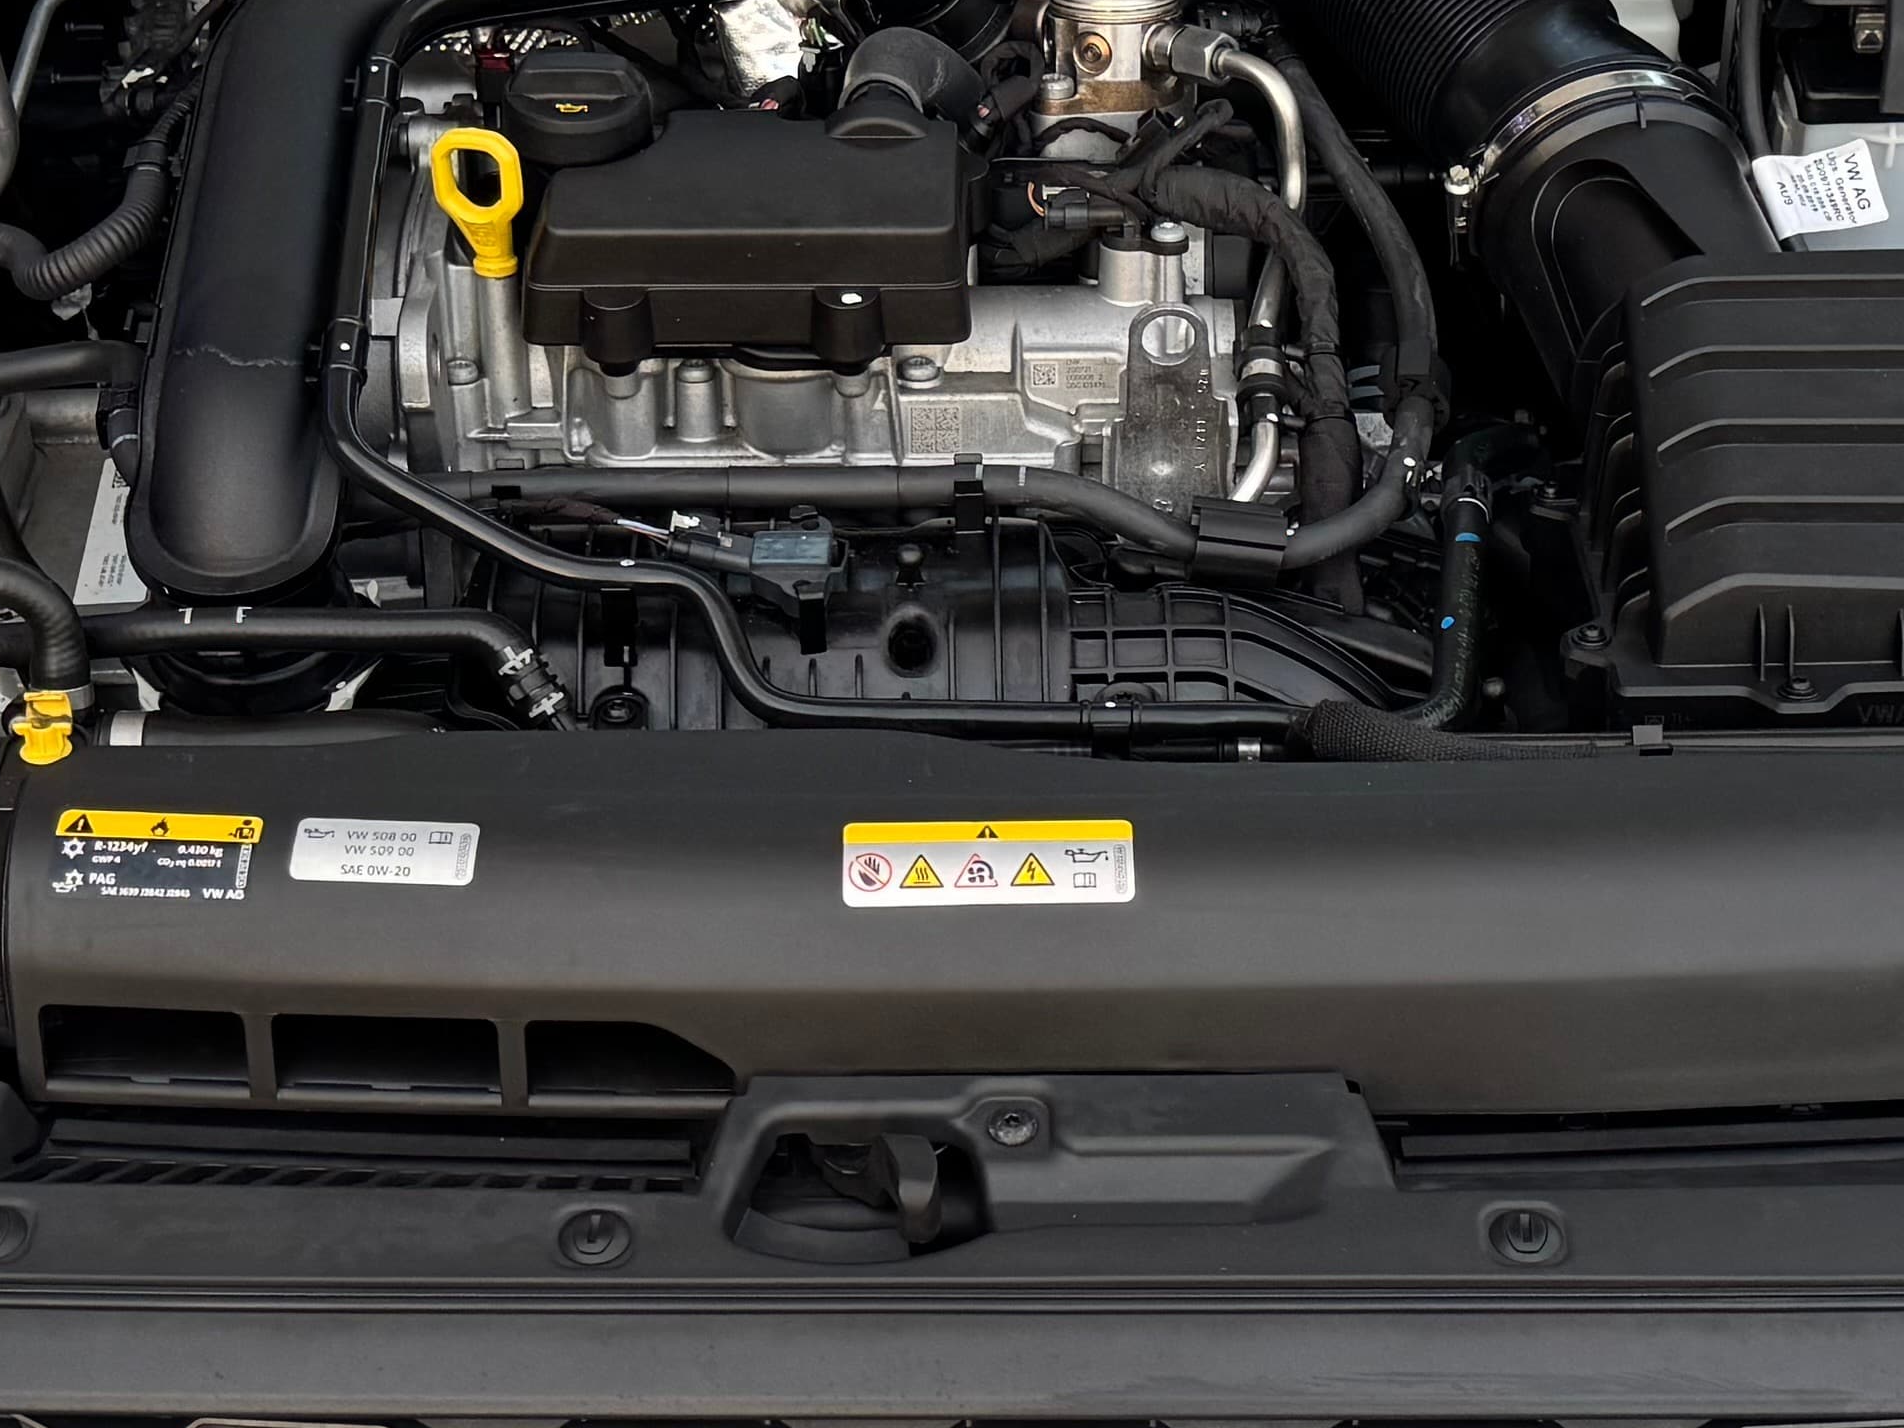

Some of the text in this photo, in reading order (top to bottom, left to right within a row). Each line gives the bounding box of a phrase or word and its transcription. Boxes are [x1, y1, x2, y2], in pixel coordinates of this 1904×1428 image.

[1844, 153, 1871, 210] VW AG
[347, 830, 417, 843] VW 508 00
[344, 844, 415, 857] VW 509 00
[340, 863, 411, 877] SAE 0W-20
[89, 872, 116, 885] PAG
[202, 888, 224, 899] VW
